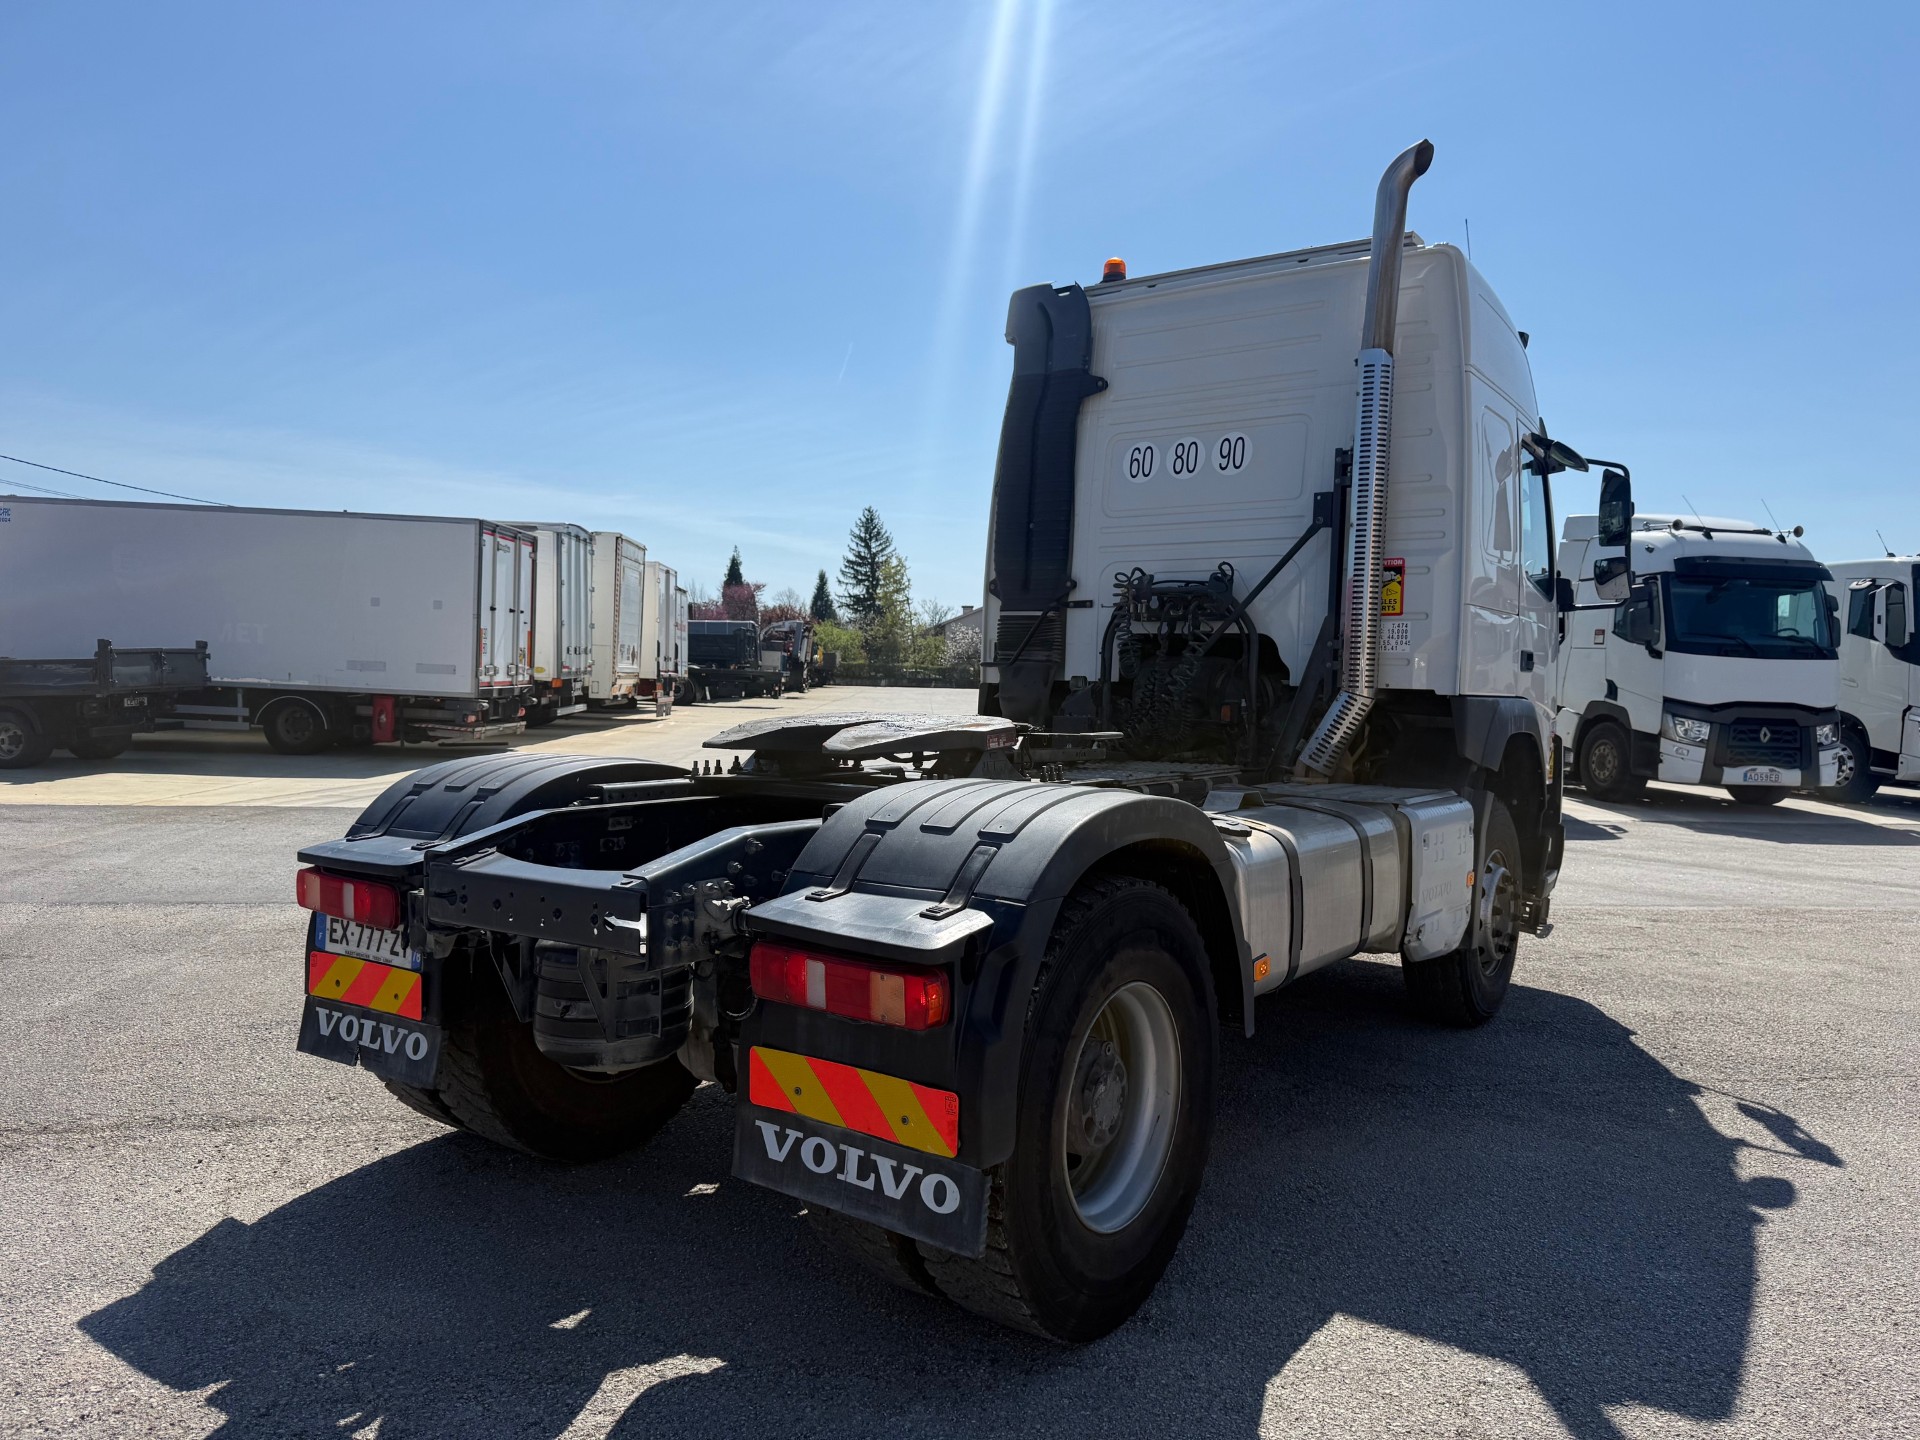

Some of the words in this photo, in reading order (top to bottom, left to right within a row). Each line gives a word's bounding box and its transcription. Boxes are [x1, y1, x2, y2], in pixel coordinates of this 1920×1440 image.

[1129, 446, 1154, 479] 60
[1173, 441, 1198, 475] 80
[1219, 436, 1245, 471] 90
[316, 1006, 428, 1061] VOLVO
[755, 1119, 961, 1214] VOLVO
